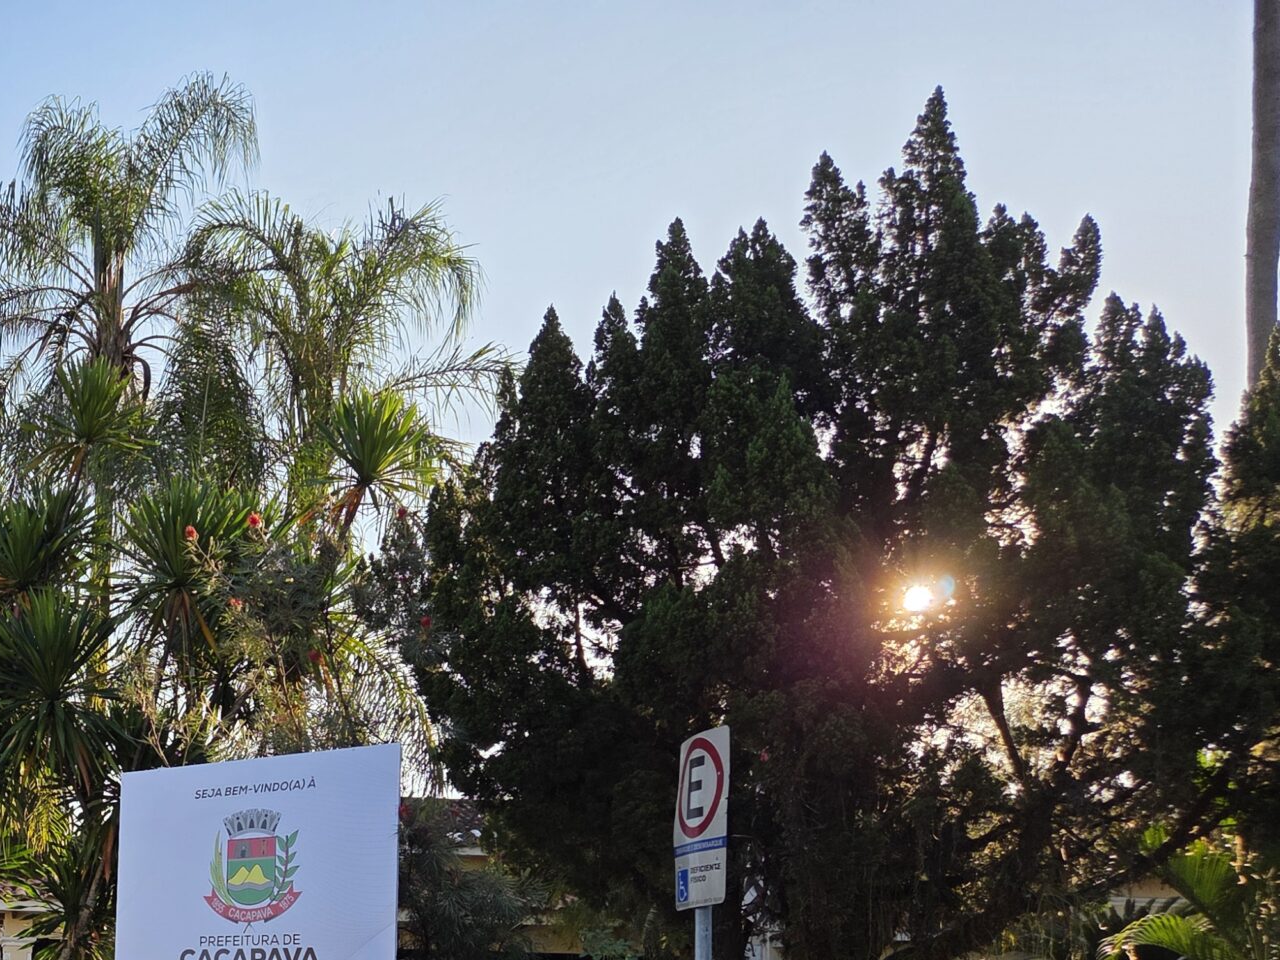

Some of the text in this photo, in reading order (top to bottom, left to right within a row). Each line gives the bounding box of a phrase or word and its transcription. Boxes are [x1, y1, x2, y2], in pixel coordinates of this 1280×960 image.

[194, 776, 316, 800] SEJA BEM-VINDO(A) À
[686, 755, 705, 820] E
[199, 934, 301, 947] PREFEITURA DE
